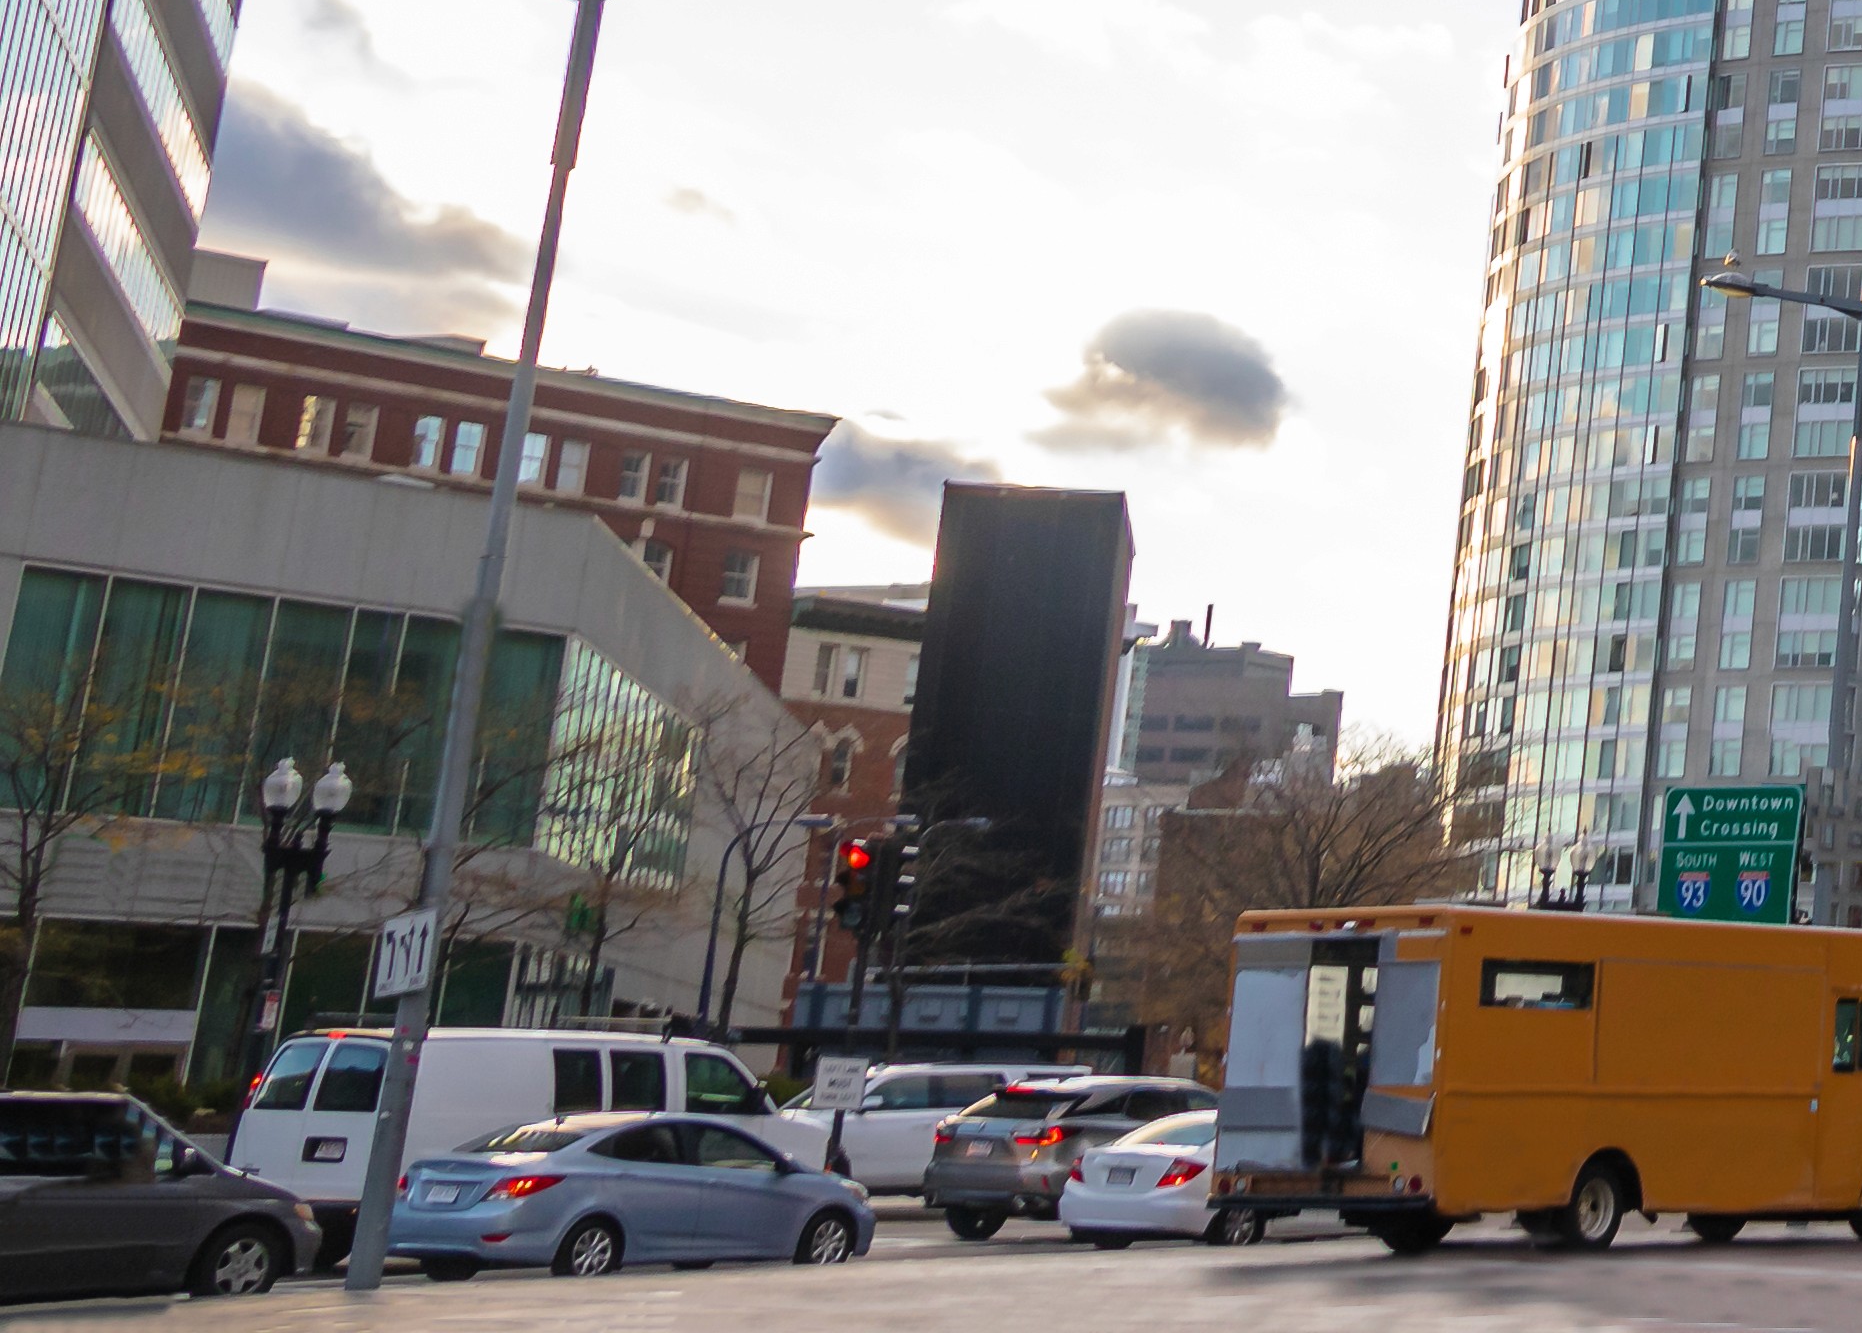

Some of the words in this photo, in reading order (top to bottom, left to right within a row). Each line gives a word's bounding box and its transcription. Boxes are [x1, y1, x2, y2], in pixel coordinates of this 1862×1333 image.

[1702, 794, 1794, 812] Downtown
[1700, 819, 1779, 840] Crossing
[1676, 850, 1718, 869] SOUTH
[1738, 849, 1776, 867] WEST
[1681, 879, 1706, 908] 93
[1740, 879, 1766, 908] 90
